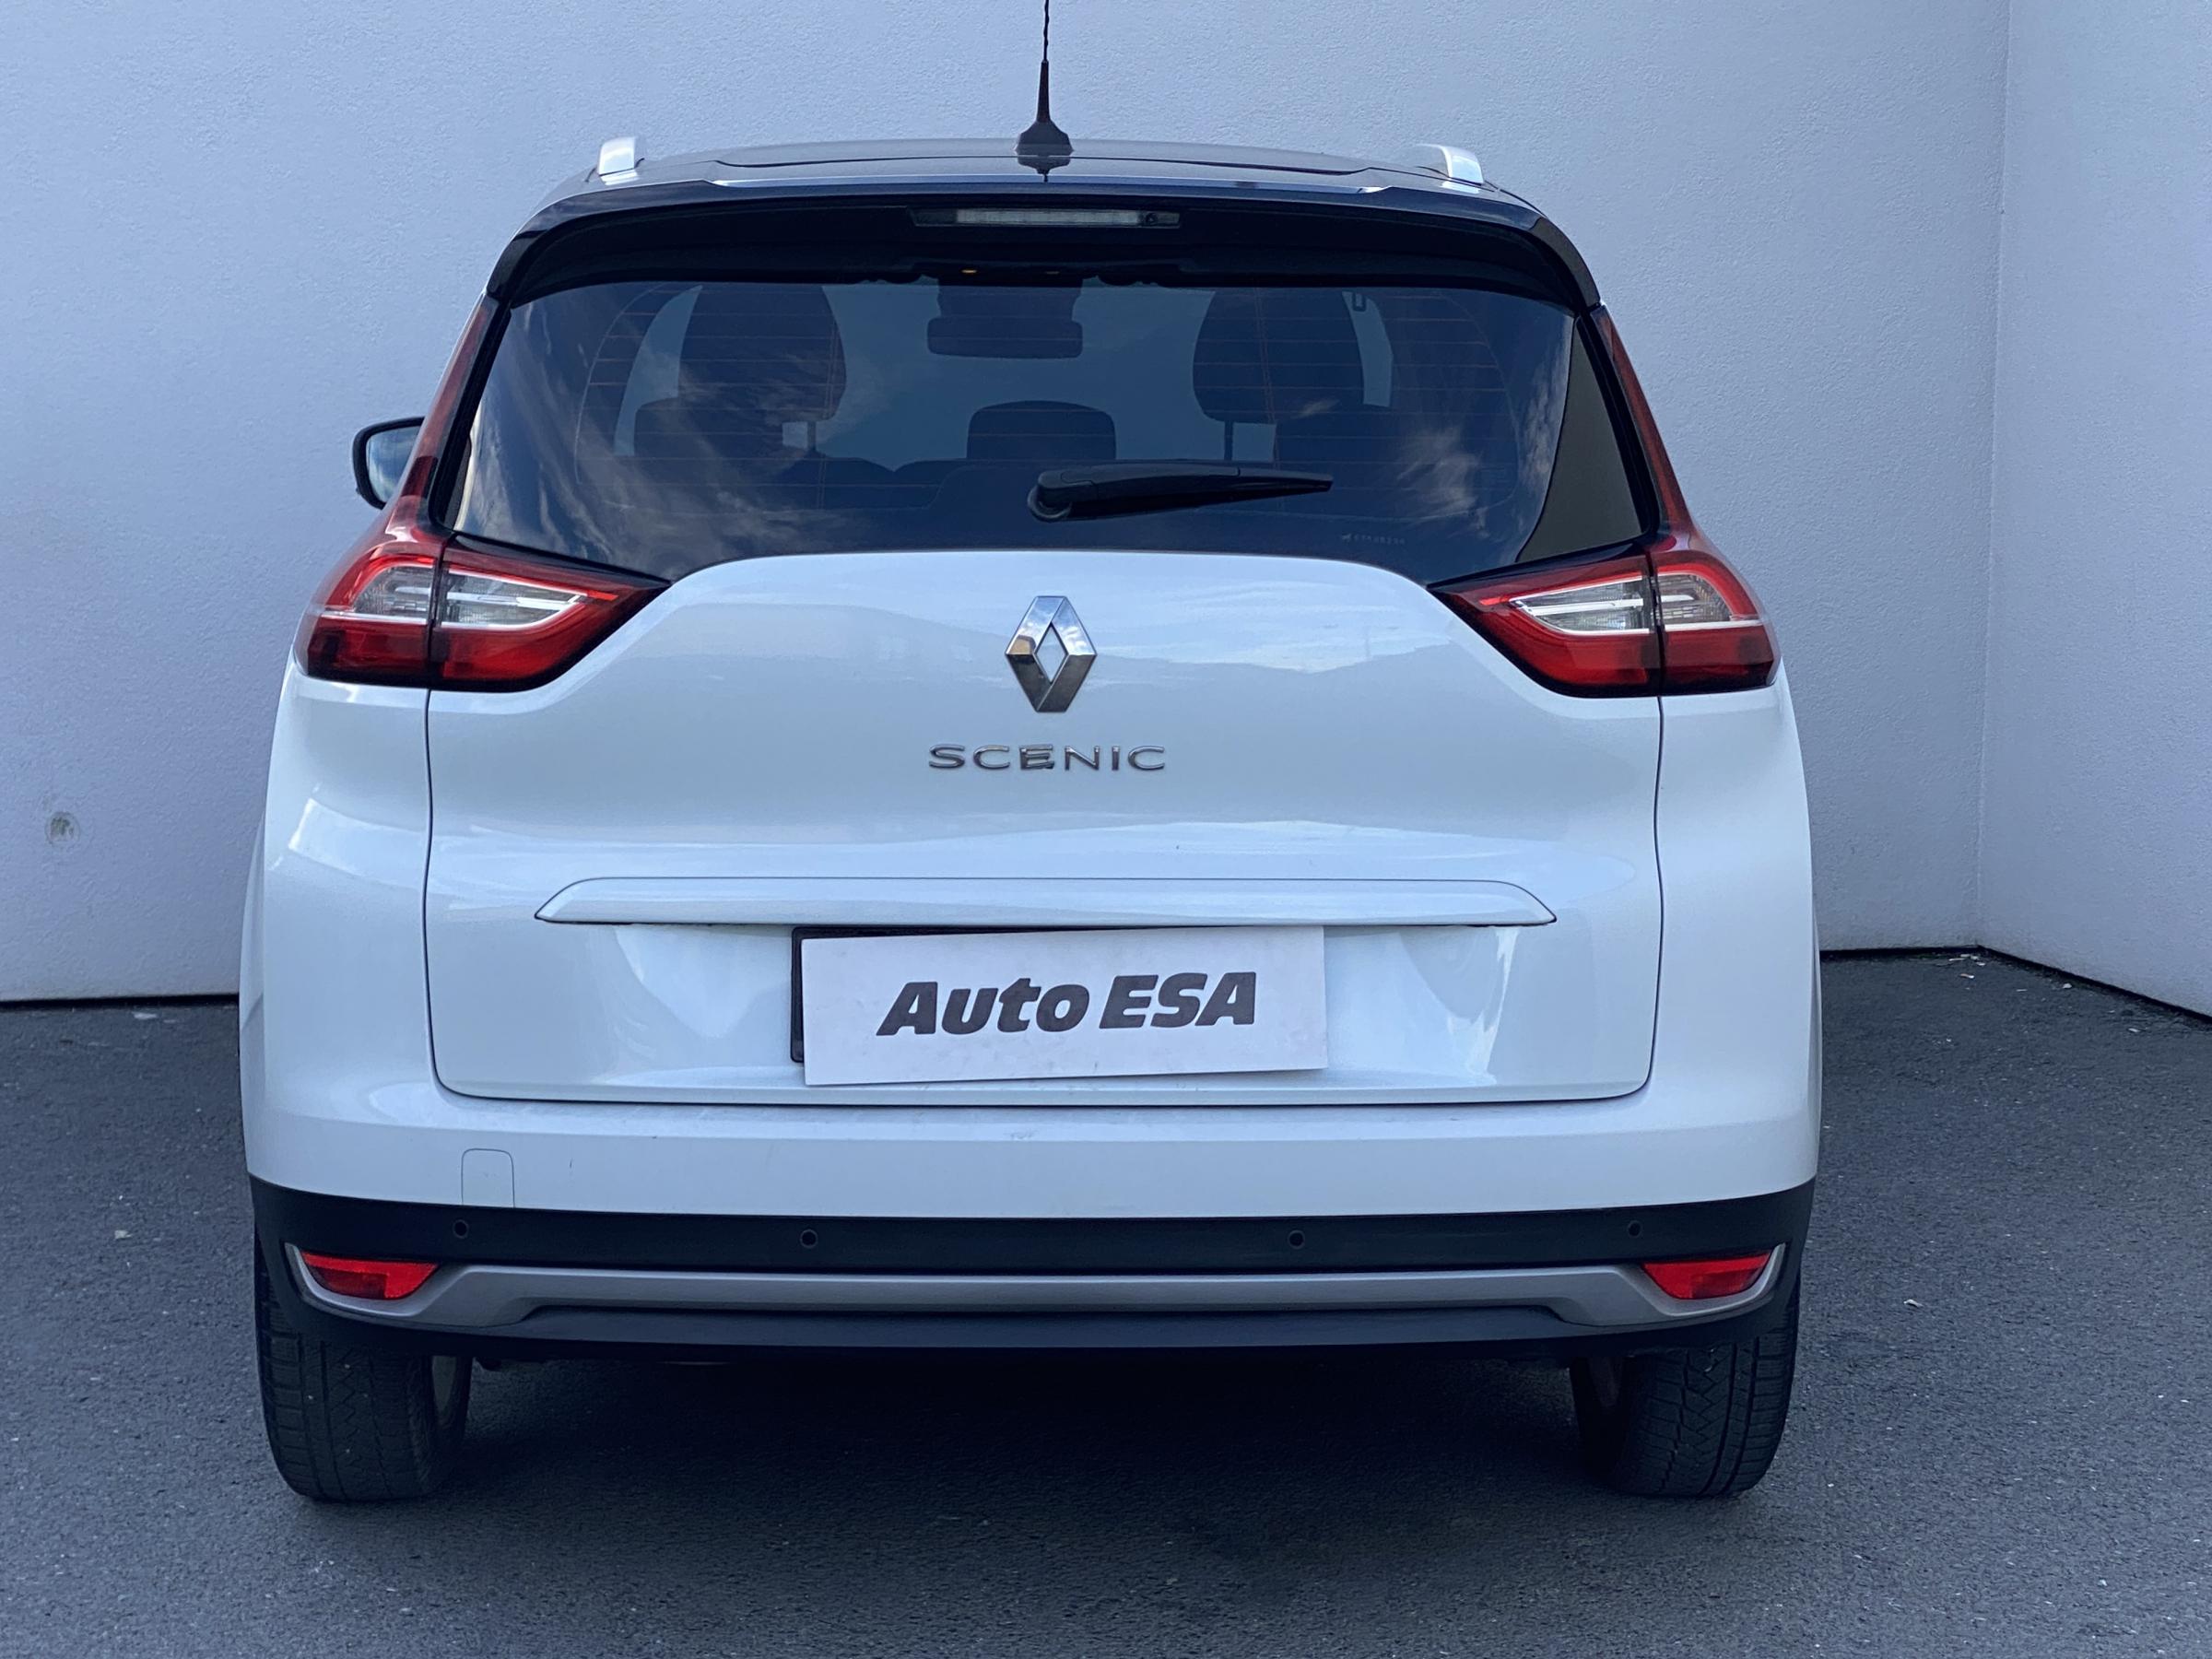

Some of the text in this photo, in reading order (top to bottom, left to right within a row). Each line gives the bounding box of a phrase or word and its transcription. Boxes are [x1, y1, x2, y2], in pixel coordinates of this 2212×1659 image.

[928, 744, 1165, 771] SCENIC
[876, 971, 1256, 1036] Auto ESA
